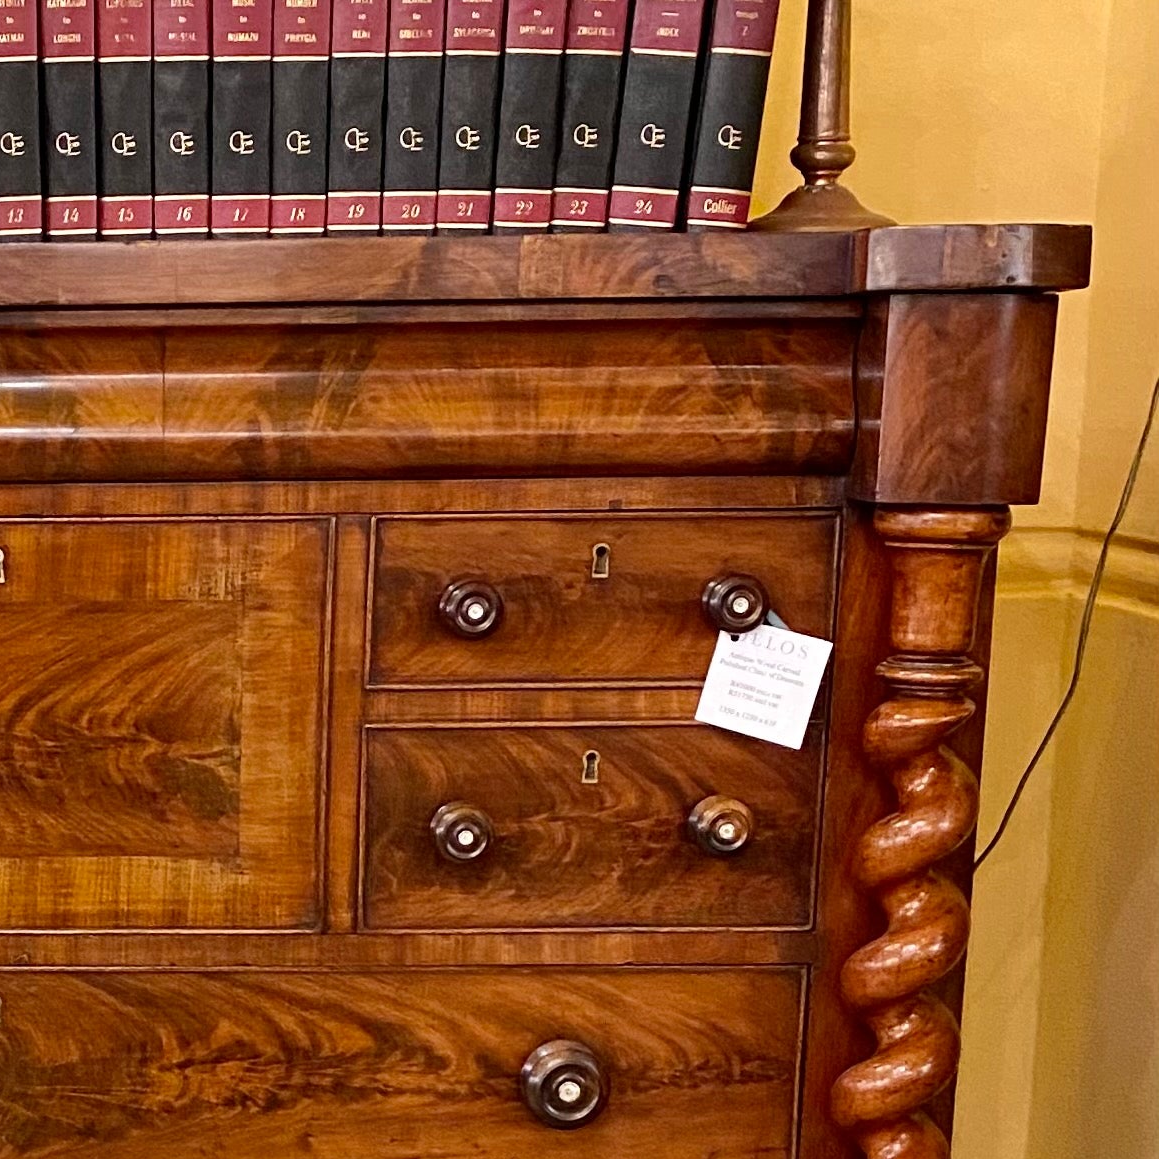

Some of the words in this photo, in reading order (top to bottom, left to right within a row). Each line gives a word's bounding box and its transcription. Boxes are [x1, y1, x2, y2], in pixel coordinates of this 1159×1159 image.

[6, 16, 14, 24] to
[62, 16, 71, 24] to
[227, 32, 259, 42] NUMAZU
[176, 206, 192, 222] 16
[233, 207, 249, 221] 17
[289, 207, 305, 221] 18
[348, 203, 365, 218] 19
[401, 204, 420, 218] 20
[457, 202, 473, 217] 21
[515, 200, 534, 215] 22
[570, 200, 589, 215] 23
[633, 200, 653, 214] 24
[704, 198, 737, 215] Collier
[8, 208, 24, 223] 13
[62, 208, 79, 223] 14
[118, 207, 134, 222] 15
